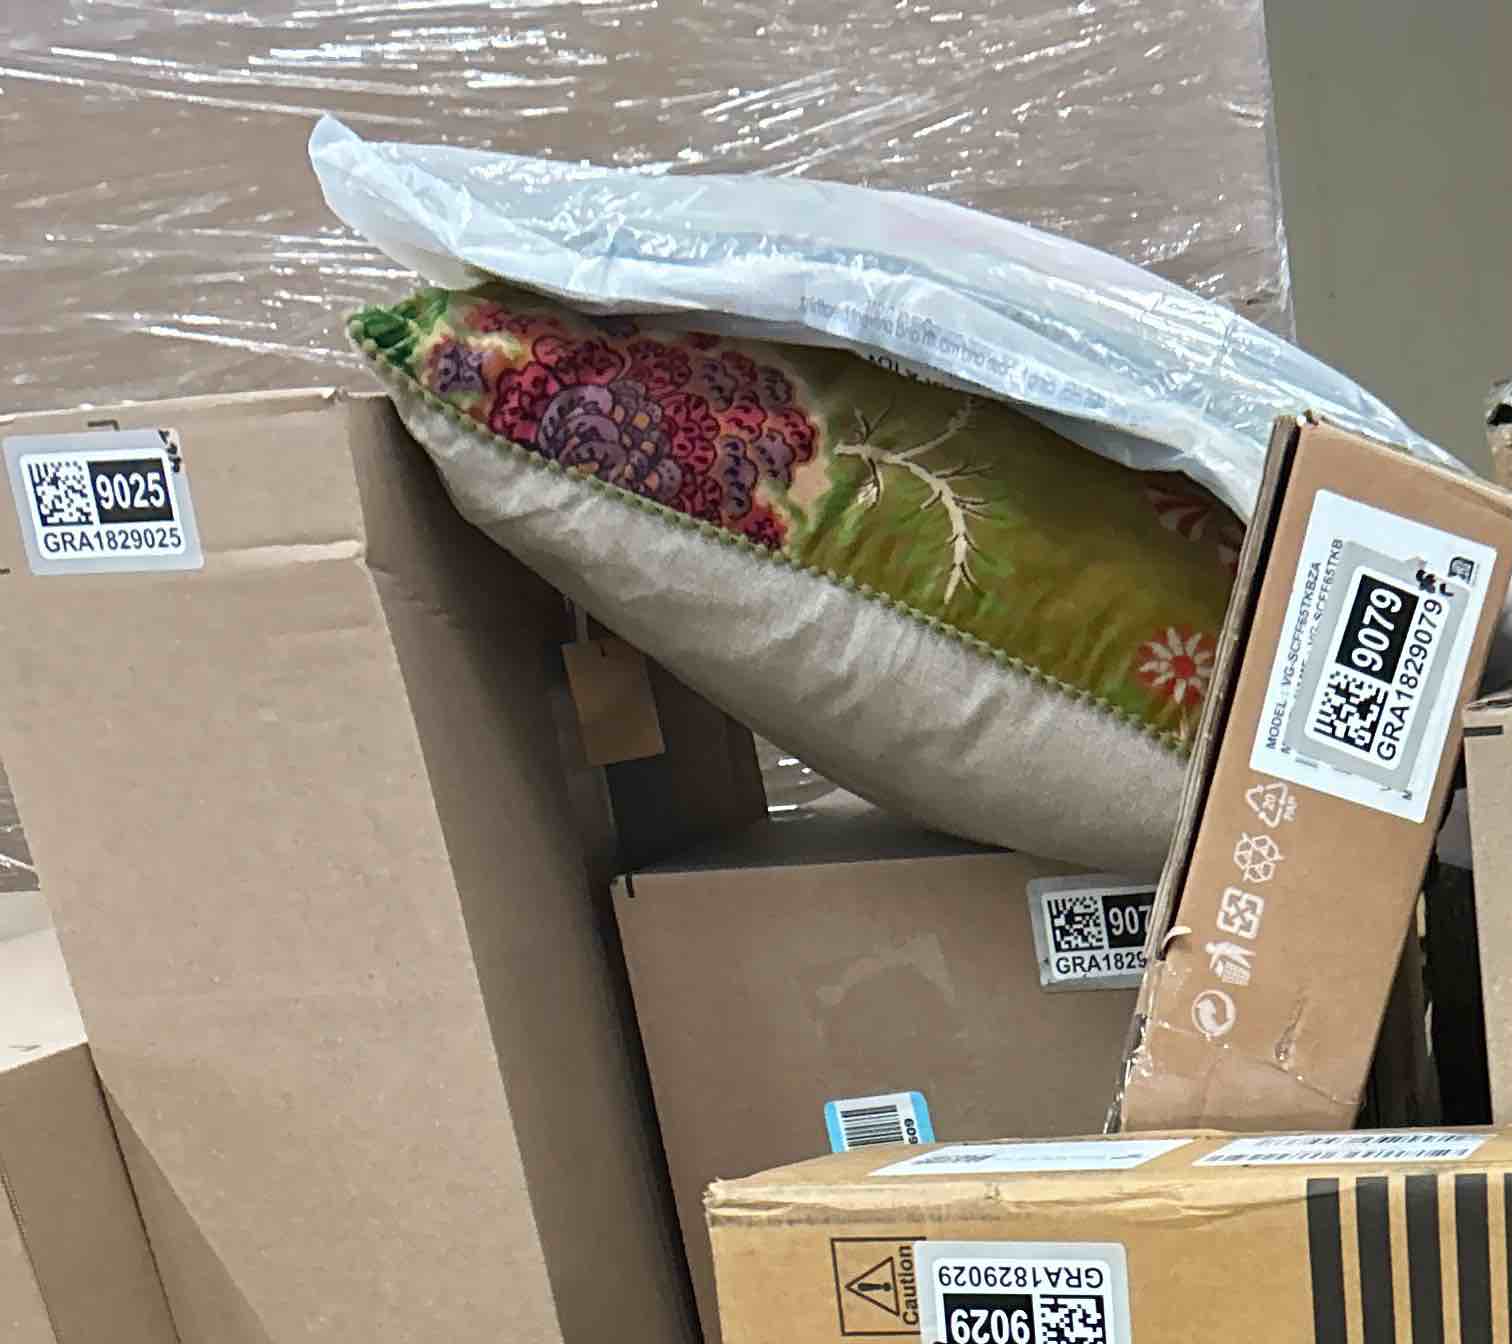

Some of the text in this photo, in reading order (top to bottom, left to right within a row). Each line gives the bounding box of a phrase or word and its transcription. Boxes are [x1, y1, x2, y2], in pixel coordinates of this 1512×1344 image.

[95, 472, 165, 511] 9025
[43, 527, 183, 554] GRA1829025
[1350, 586, 1404, 674] 9079
[1375, 598, 1444, 762] GRA1829079
[1265, 703, 1289, 751] MODEL
[898, 1245, 920, 1327] Caution
[938, 1264, 1105, 1290] GRA1829029
